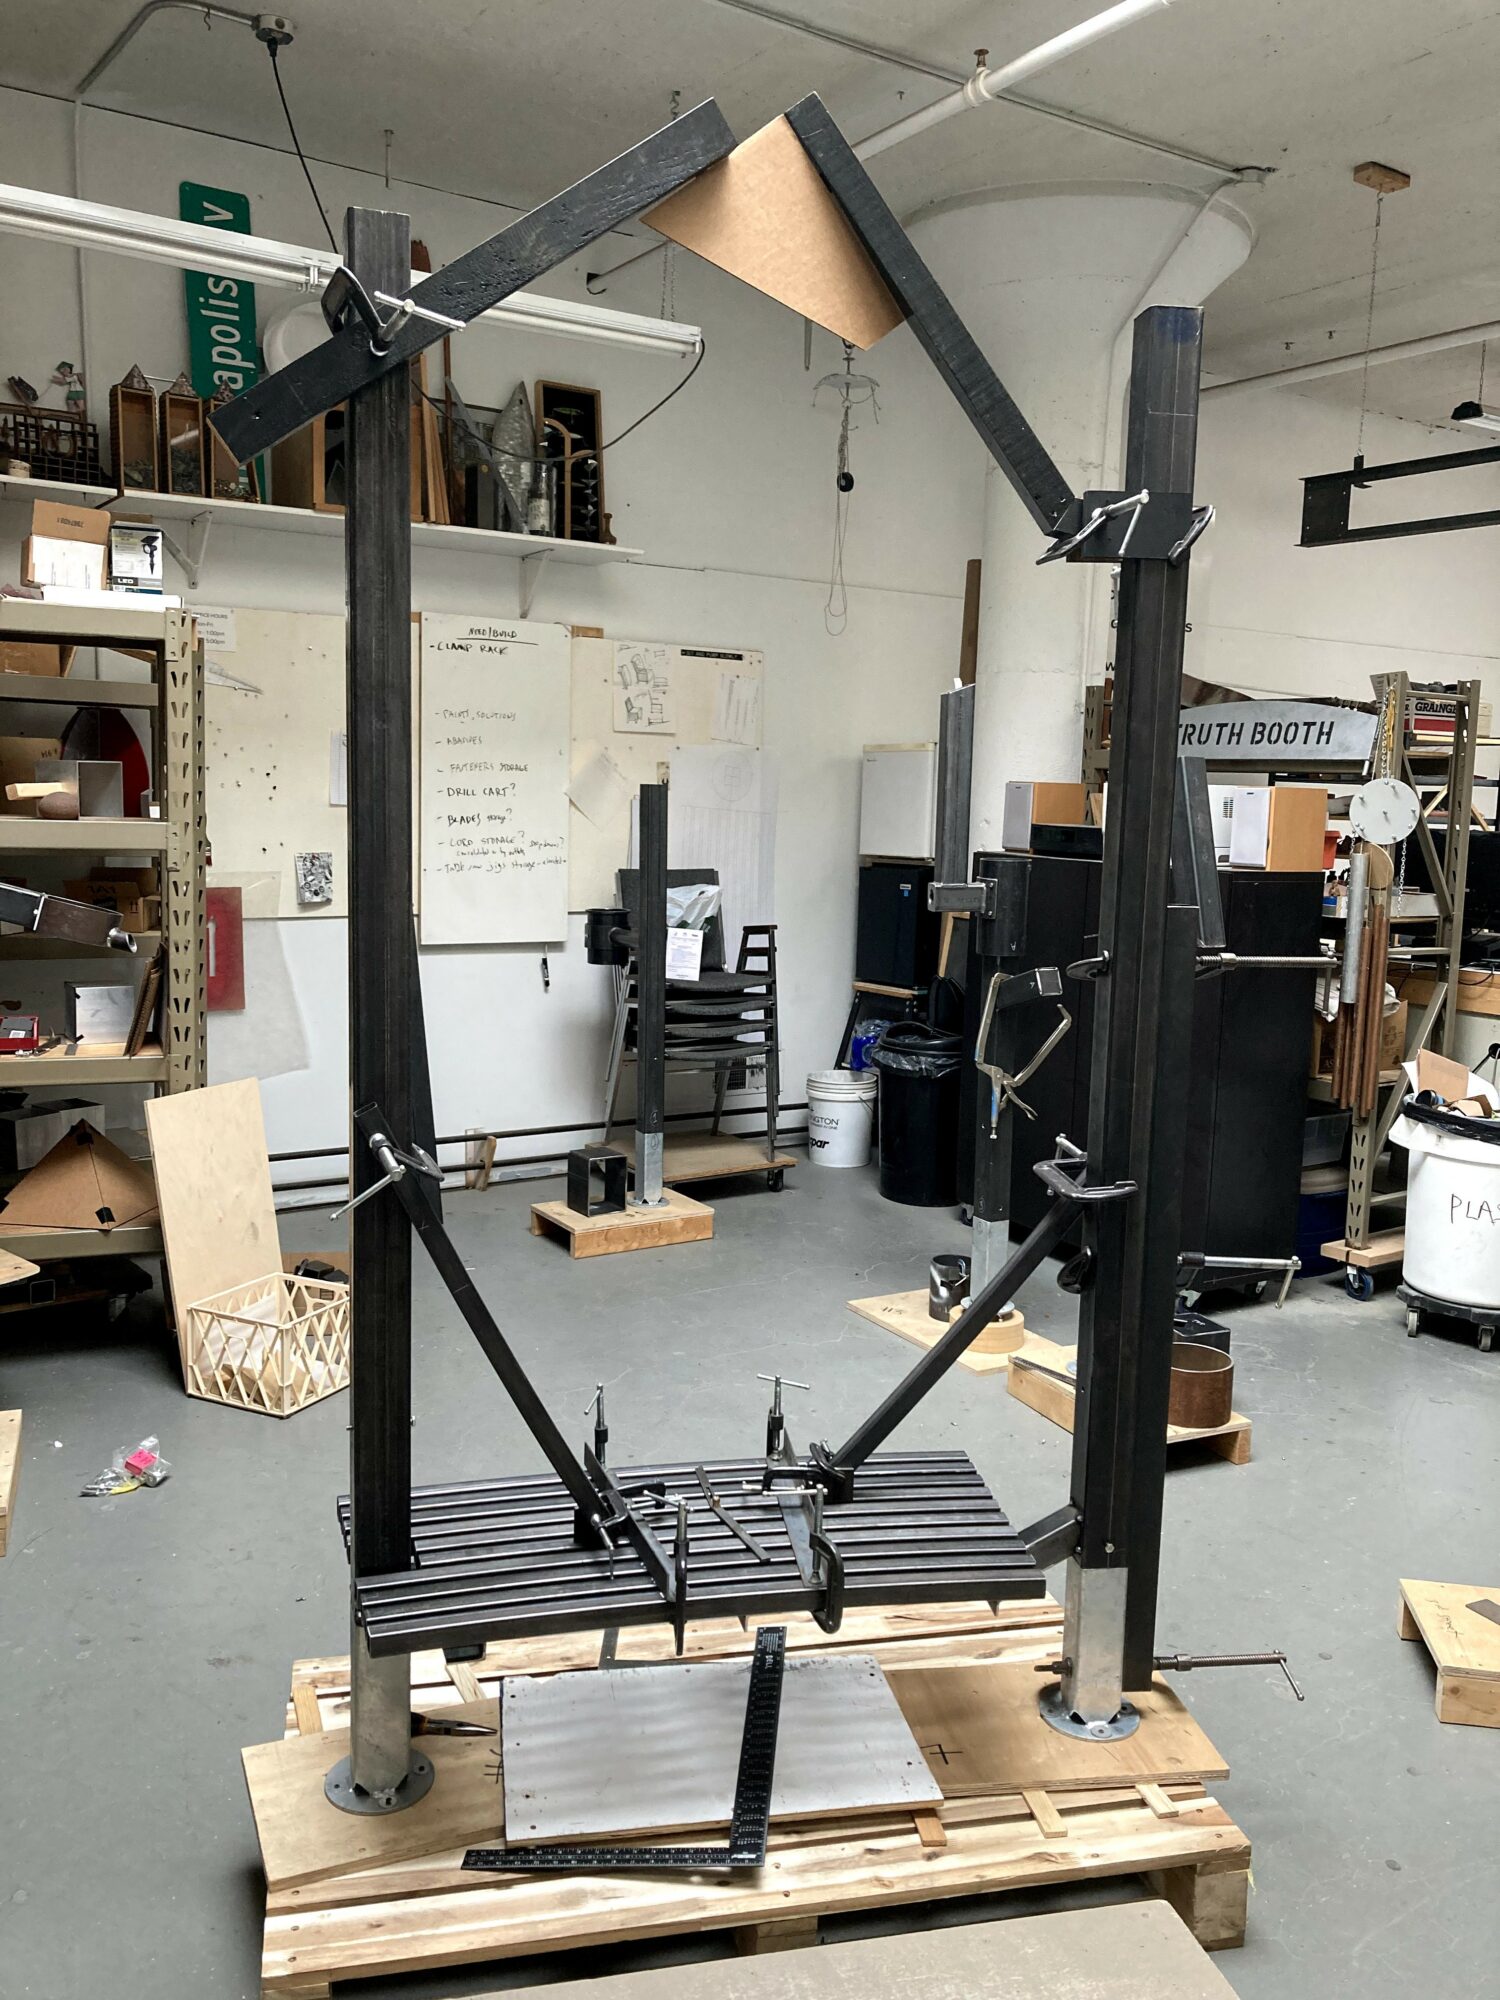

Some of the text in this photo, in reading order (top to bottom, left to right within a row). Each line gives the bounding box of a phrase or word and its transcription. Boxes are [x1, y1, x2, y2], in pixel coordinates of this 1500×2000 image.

[437, 641, 509, 655] CLAMP RACK
[1177, 721, 1334, 745] RUTH BOOTH
[447, 782, 516, 797] DRILL CART?
[447, 813, 481, 827] BLADES
